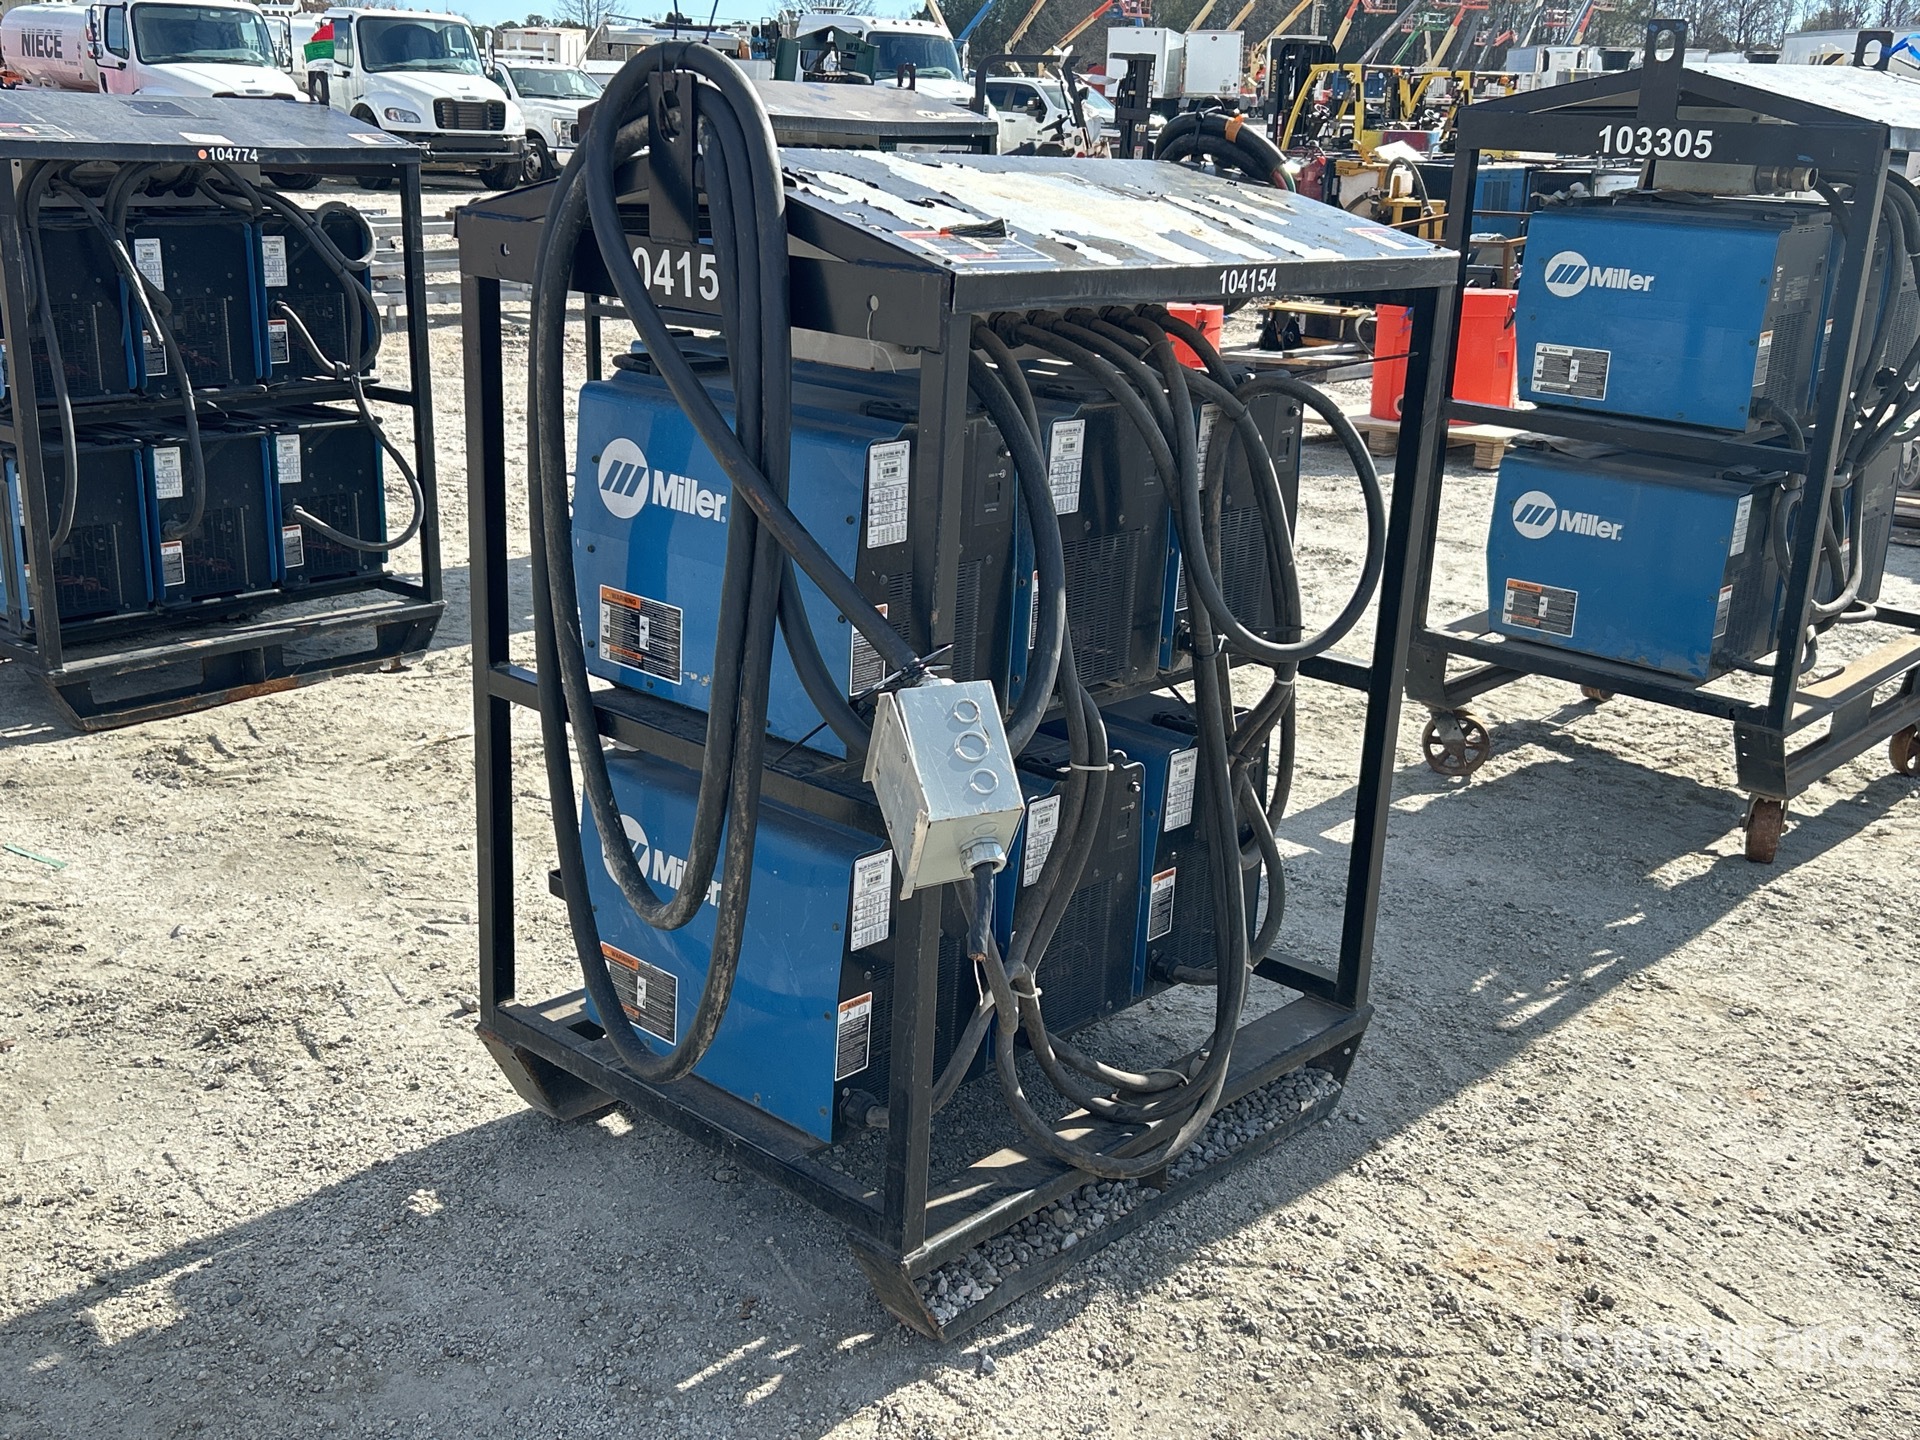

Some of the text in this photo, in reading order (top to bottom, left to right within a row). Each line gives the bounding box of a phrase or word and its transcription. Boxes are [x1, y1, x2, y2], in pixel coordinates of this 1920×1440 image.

[21, 28, 63, 59] NIECE
[1270, 59, 1278, 93] HYSTER
[1134, 123, 1147, 133] CAT
[208, 147, 259, 162] 104774
[1599, 125, 1713, 159] 103305
[1219, 268, 1277, 294] 104154
[1590, 266, 1655, 292] Miller
[652, 469, 727, 523] Miller
[1559, 509, 1623, 541] Miller
[611, 593, 637, 606] WARNING
[611, 950, 635, 966] WARNING
